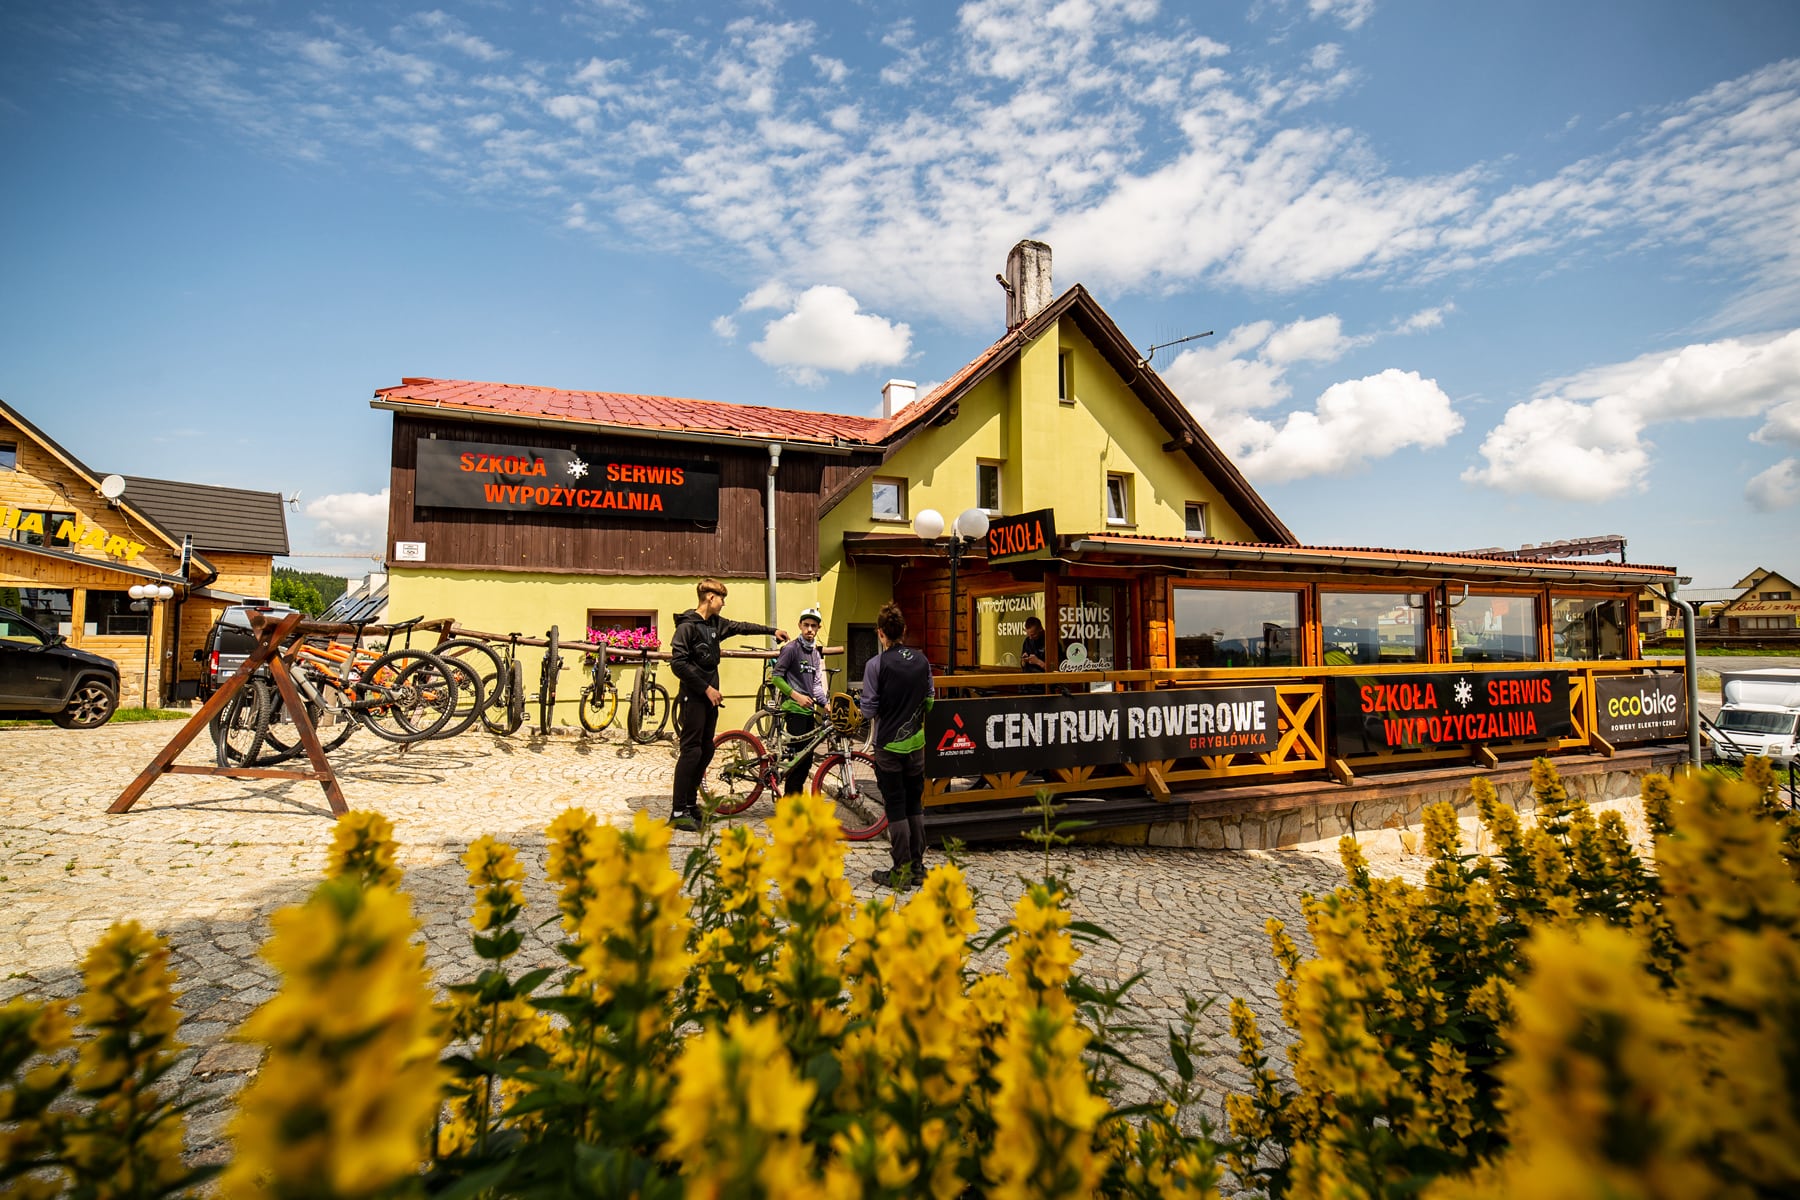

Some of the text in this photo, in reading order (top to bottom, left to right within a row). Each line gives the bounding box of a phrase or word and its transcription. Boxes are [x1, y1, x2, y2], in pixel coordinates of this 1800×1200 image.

[459, 452, 685, 486] SZKOŁA SERWIS
[483, 483, 664, 512] WYPOŻYCZALNIA
[56, 519, 146, 561] NART
[989, 520, 1046, 556] SZKOŁA
[997, 621, 1028, 636] SERWIS
[1059, 607, 1111, 622] SERWIS
[1060, 624, 1111, 639] SZKOŁA
[1360, 678, 1552, 713] SZKOŁA SERWIS
[1607, 687, 1677, 718] ecobike
[985, 700, 1267, 750] CENTRUM ROWEROWE
[1189, 731, 1267, 750] GRYGLÓWKA
[1383, 709, 1538, 746] WYPOŻYCZALNIA
[1611, 719, 1677, 732] ROWERY ELEKTRYCZNE
